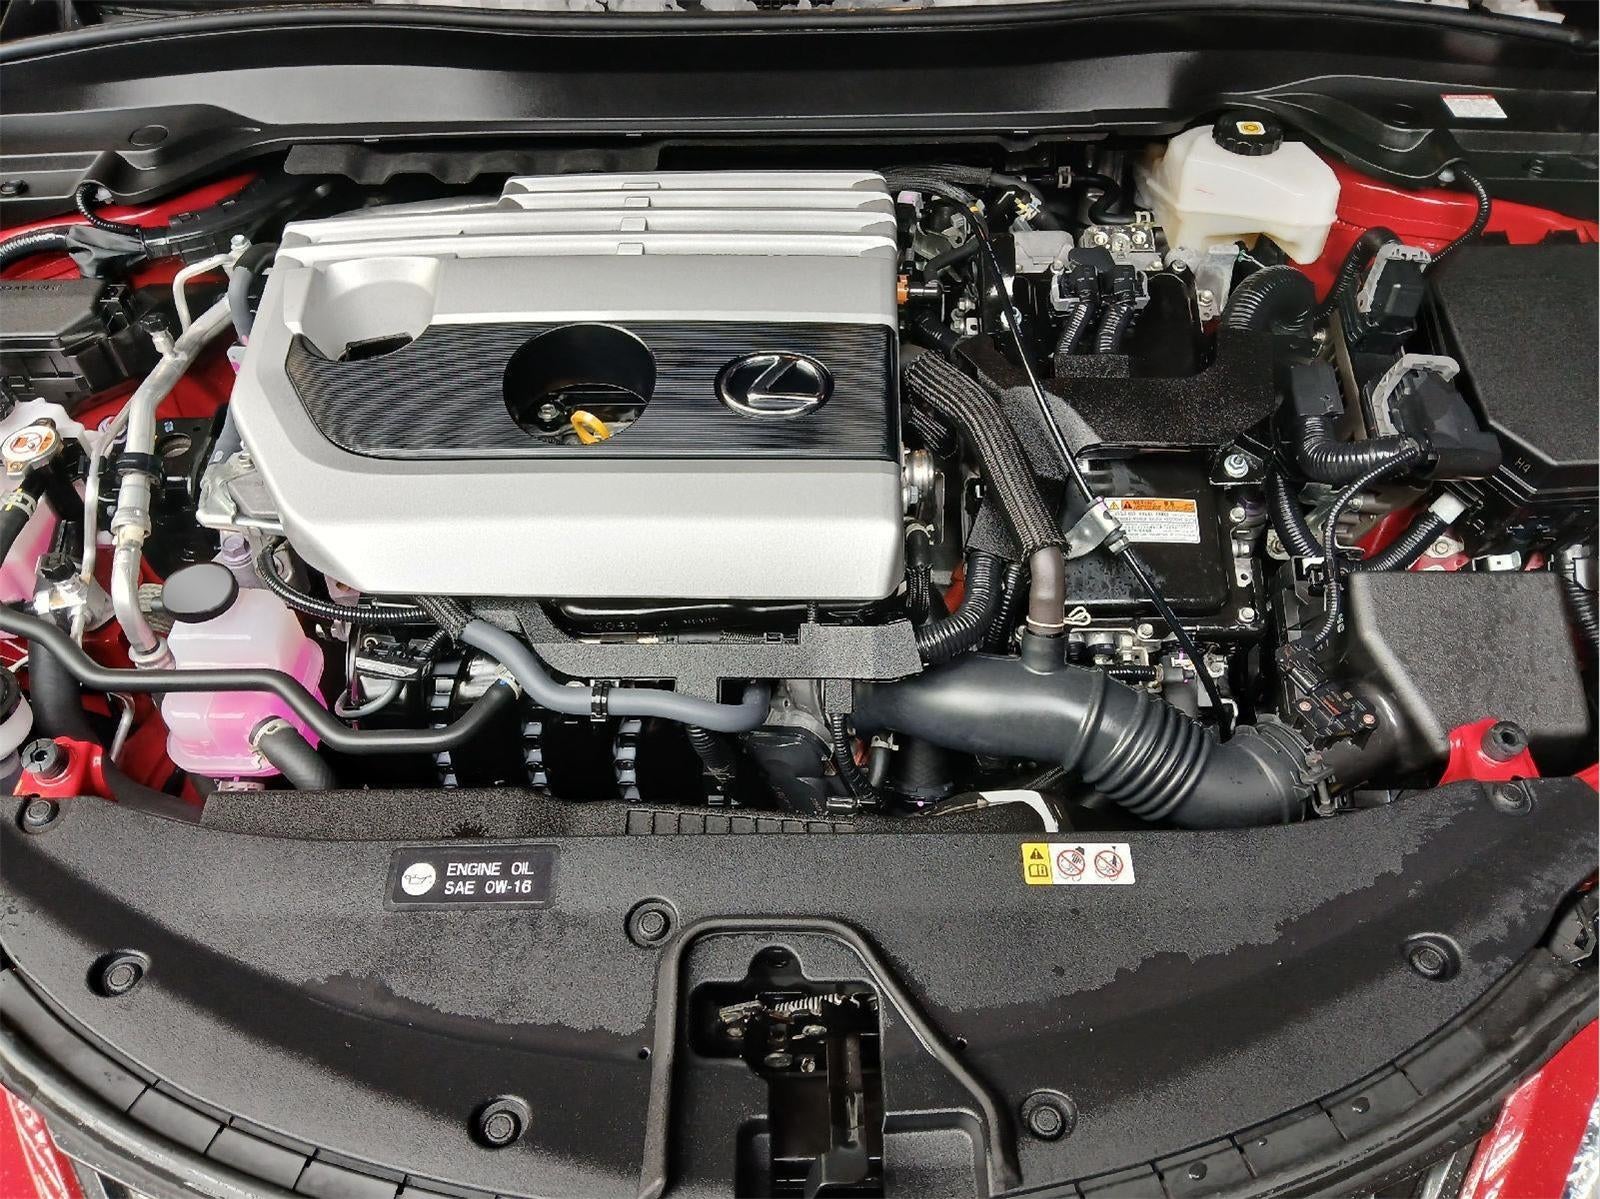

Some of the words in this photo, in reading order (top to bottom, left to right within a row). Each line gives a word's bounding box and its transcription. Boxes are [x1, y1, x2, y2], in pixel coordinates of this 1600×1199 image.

[446, 862, 503, 877] ENGINE
[511, 861, 534, 876] OIL
[444, 881, 475, 895] SAE
[485, 880, 532, 894] 0W-16
